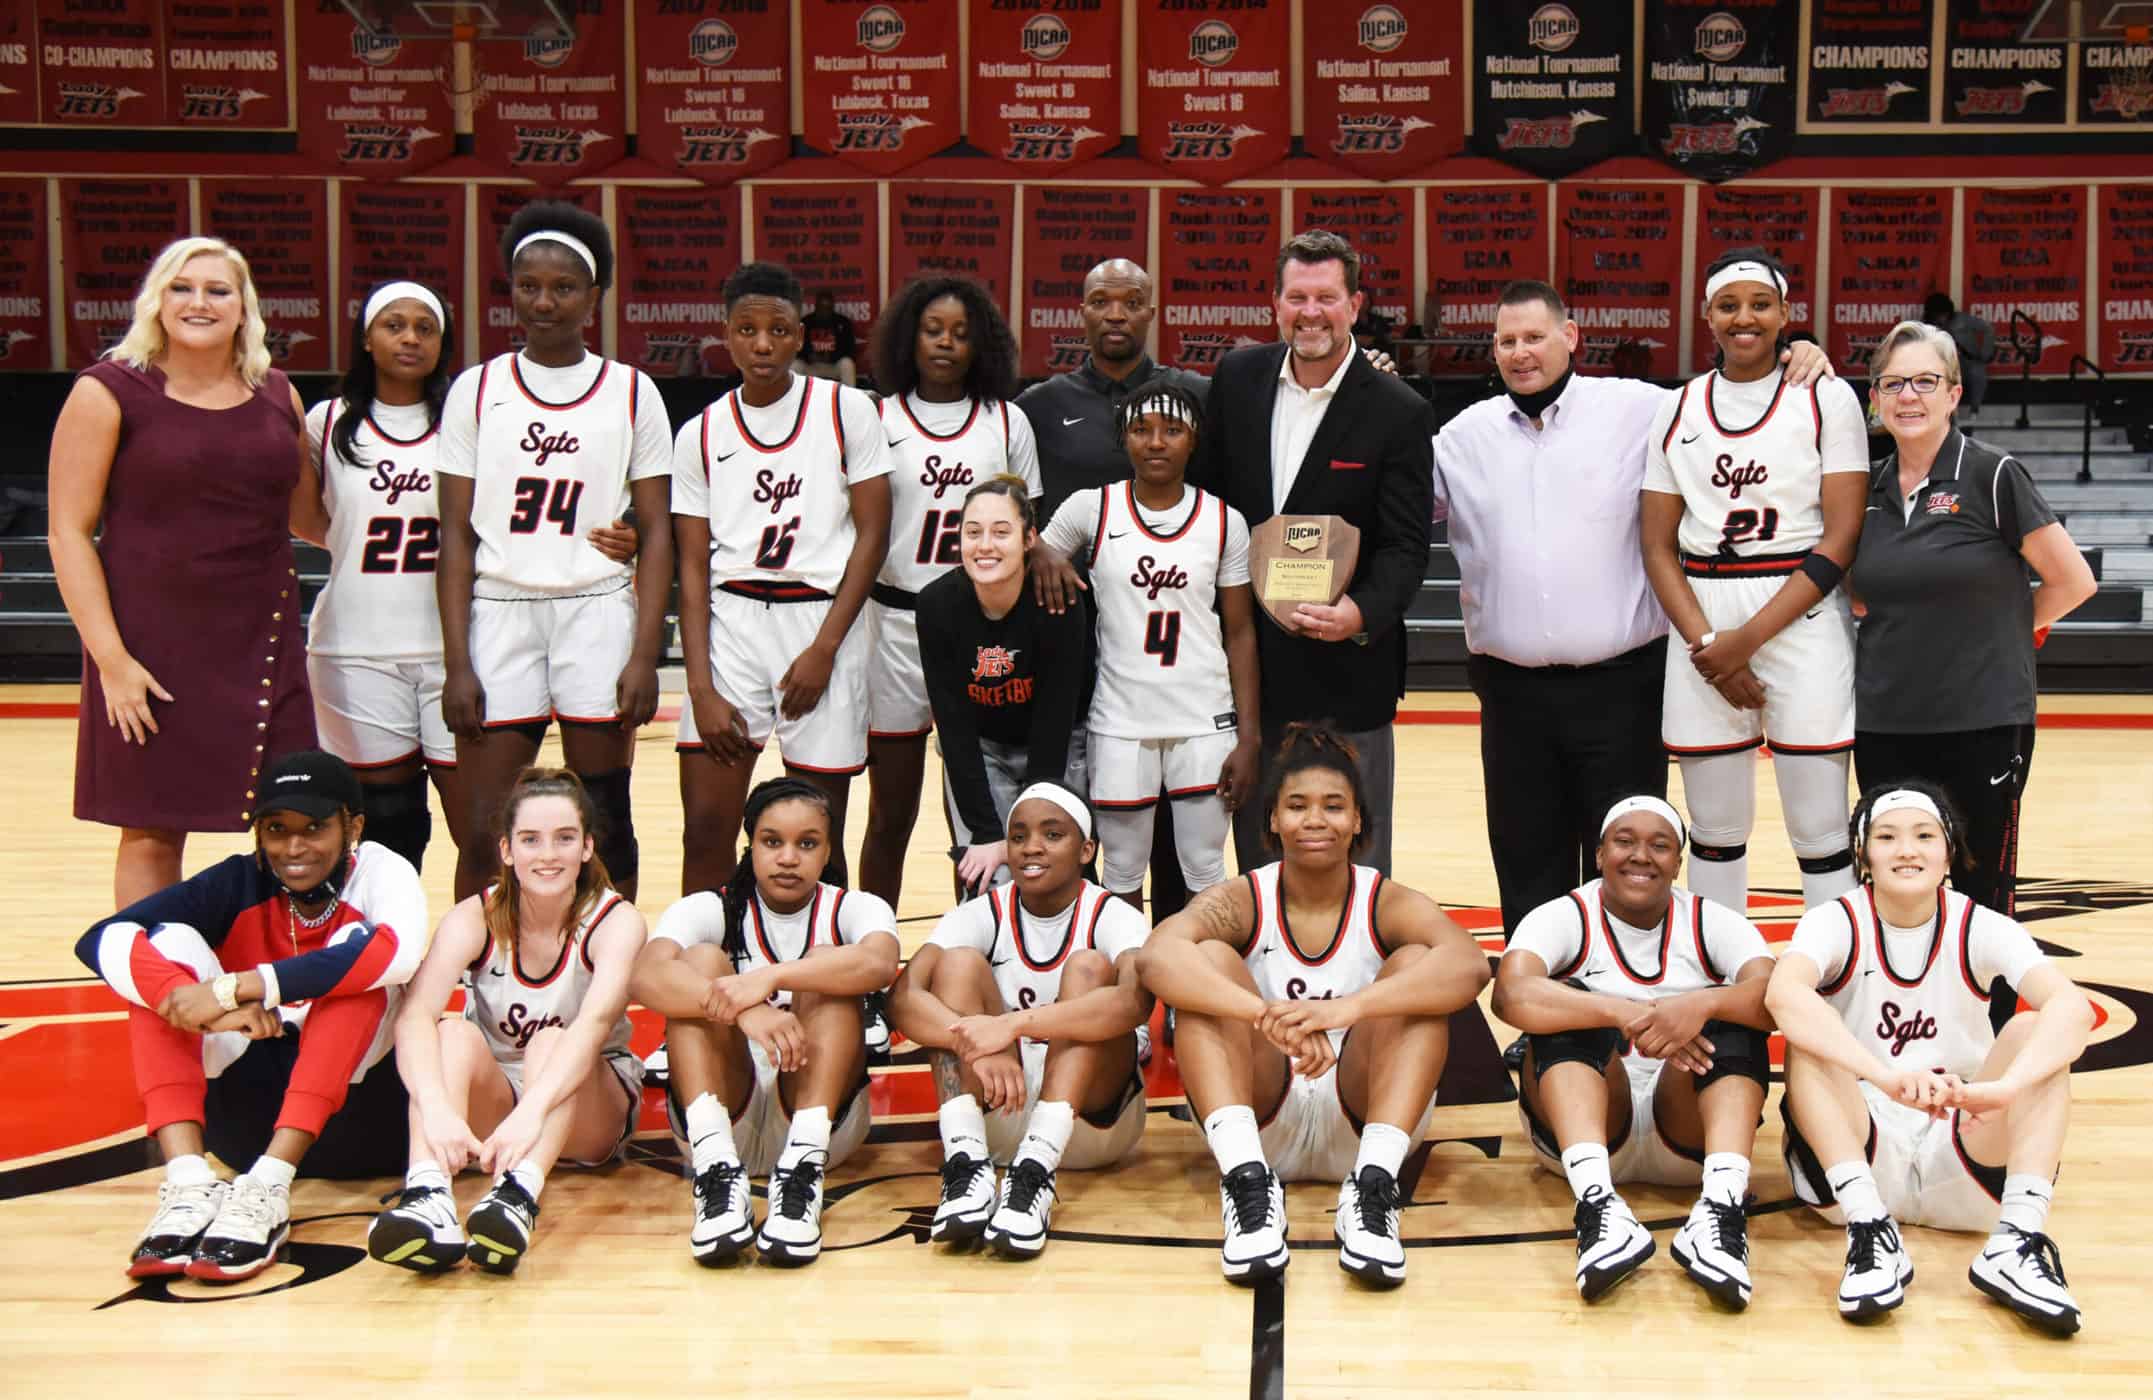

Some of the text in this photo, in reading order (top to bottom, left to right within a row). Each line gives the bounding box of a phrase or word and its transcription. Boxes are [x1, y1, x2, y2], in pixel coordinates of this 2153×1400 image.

[859, 20, 904, 42] NJCAA
[1023, 28, 1070, 49] NJCAA
[1360, 20, 1407, 42] NJCAA
[1531, 20, 1578, 43] NJCAA
[1699, 27, 1745, 49] NJCAA
[691, 34, 737, 56] NJCAA
[1191, 35, 1237, 57] NJCAA
[44, 45, 155, 70] CO-CHAMPIONS
[169, 48, 279, 72] CHAMPIONS
[814, 53, 948, 72] National Tournament
[1486, 53, 1621, 75] National Tournament
[1812, 45, 1929, 69] CHAMPIONS
[1952, 47, 2063, 70] CHAMPIONS
[2086, 46, 2153, 69] CHAMP
[308, 65, 445, 82] National Tournament
[647, 66, 782, 84] National Tournament
[979, 62, 1112, 79] National Tournament
[1147, 68, 1281, 88] National Tournament
[1317, 58, 1451, 79] National Tournament
[1651, 62, 1786, 84] National Tournament
[61, 82, 109, 96] Lady
[185, 84, 230, 97] Lady
[539, 74, 616, 93] Tournament
[851, 76, 894, 91] Sweet
[1016, 82, 1076, 99] Sweet 16
[1337, 83, 1431, 104] Salina, Kansas
[1490, 80, 1617, 101] Hutchinson, Kansas
[349, 86, 407, 104] Qualifier
[685, 88, 729, 104] Sweet
[832, 94, 930, 110] Lubbock, Texas
[1184, 93, 1245, 112] Sweet 16
[1687, 88, 1728, 107] Sweet
[1823, 90, 1888, 114] JETS
[59, 96, 118, 116] JETS
[184, 98, 241, 118] JETS
[389, 105, 428, 121] Texas
[560, 103, 600, 121] Texas
[664, 107, 764, 124] Lubbock, Texas
[1000, 103, 1092, 120] Salina, Kansas
[840, 114, 888, 126] Lady
[1010, 123, 1064, 136] Lady
[1169, 121, 1225, 134] Lady
[1339, 114, 1393, 127] Lady
[346, 125, 402, 139] Lady
[518, 125, 571, 139] Lady
[683, 127, 737, 139] Lady
[838, 129, 902, 149] JETS
[1337, 130, 1404, 151] JETS
[1505, 120, 1572, 146] JETS
[1670, 126, 1738, 153] JETS
[341, 139, 412, 161] JETS
[514, 143, 582, 164] JETS
[680, 141, 748, 162] JETS
[1007, 138, 1073, 160] JETS
[1167, 137, 1234, 158] JETS
[1164, 304, 1273, 327] CHAMPIONS
[520, 422, 580, 467] Sgtc
[369, 459, 431, 505] Sgtc
[920, 454, 974, 499] Sgtc
[1711, 453, 1769, 500] Sgtc
[509, 476, 585, 536] 34
[915, 509, 964, 564] 12
[1287, 527, 1321, 541] NJCAA
[360, 516, 440, 574] 22
[1276, 561, 1327, 571] CHAMPION
[1130, 555, 1188, 600] Sgtc
[1143, 610, 1181, 667] 4
[971, 656, 1016, 682] JETS
[1876, 1001, 1938, 1057] Sgtc
